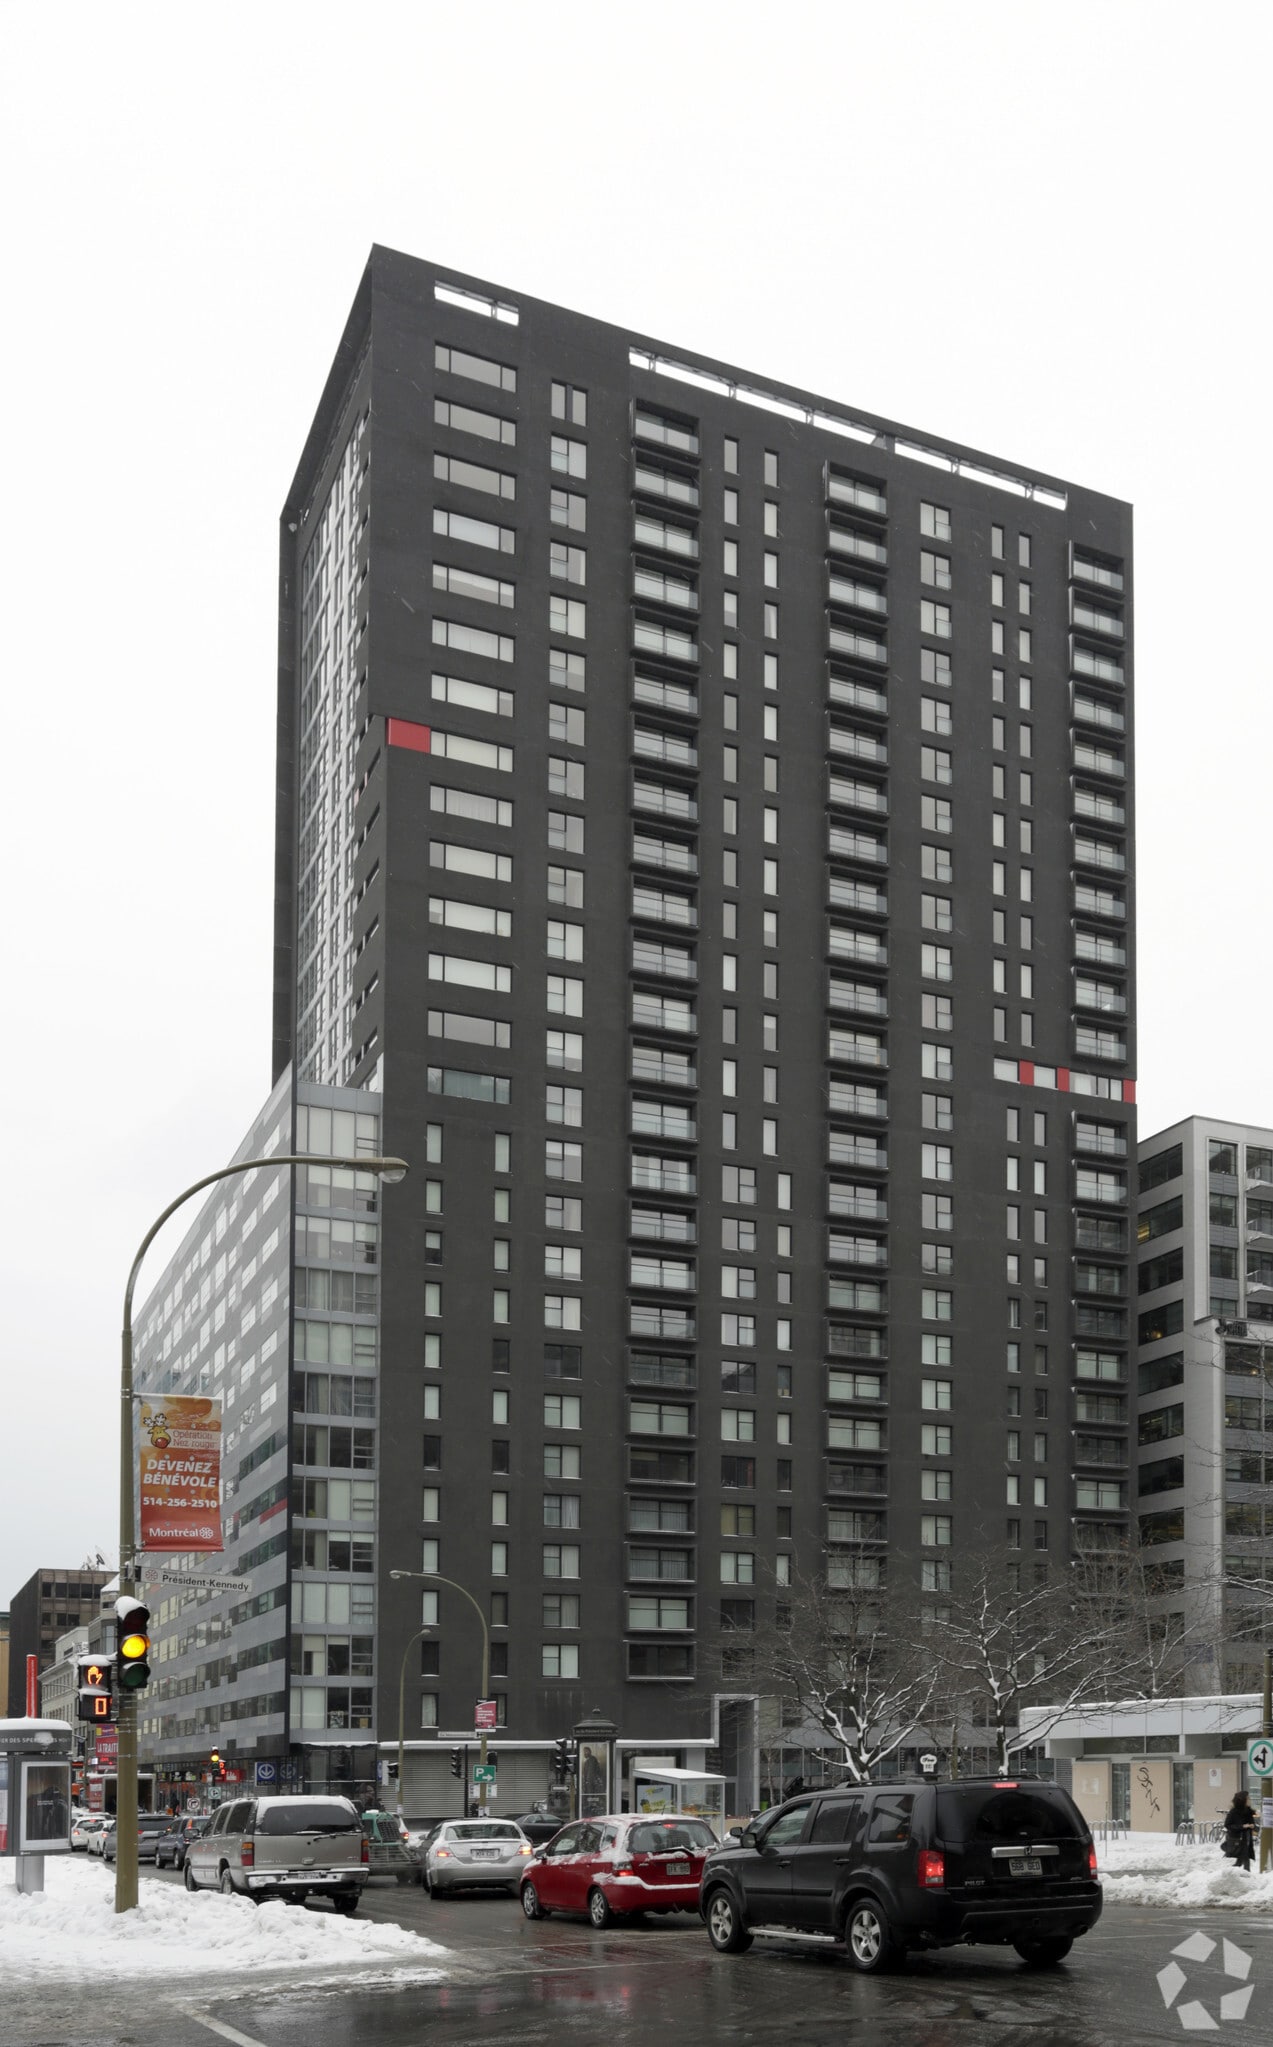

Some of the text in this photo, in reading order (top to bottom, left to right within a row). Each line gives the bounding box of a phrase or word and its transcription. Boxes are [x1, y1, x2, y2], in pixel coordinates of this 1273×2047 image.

[147, 1459, 213, 1474] DEVENEZ
[143, 1472, 217, 1488] BÉNÉVOLE
[143, 1497, 217, 1509] 514-256-2510
[149, 1527, 199, 1537] Montréal
[162, 1574, 249, 1592] Président-Kennedy
[475, 1768, 485, 1777] P
